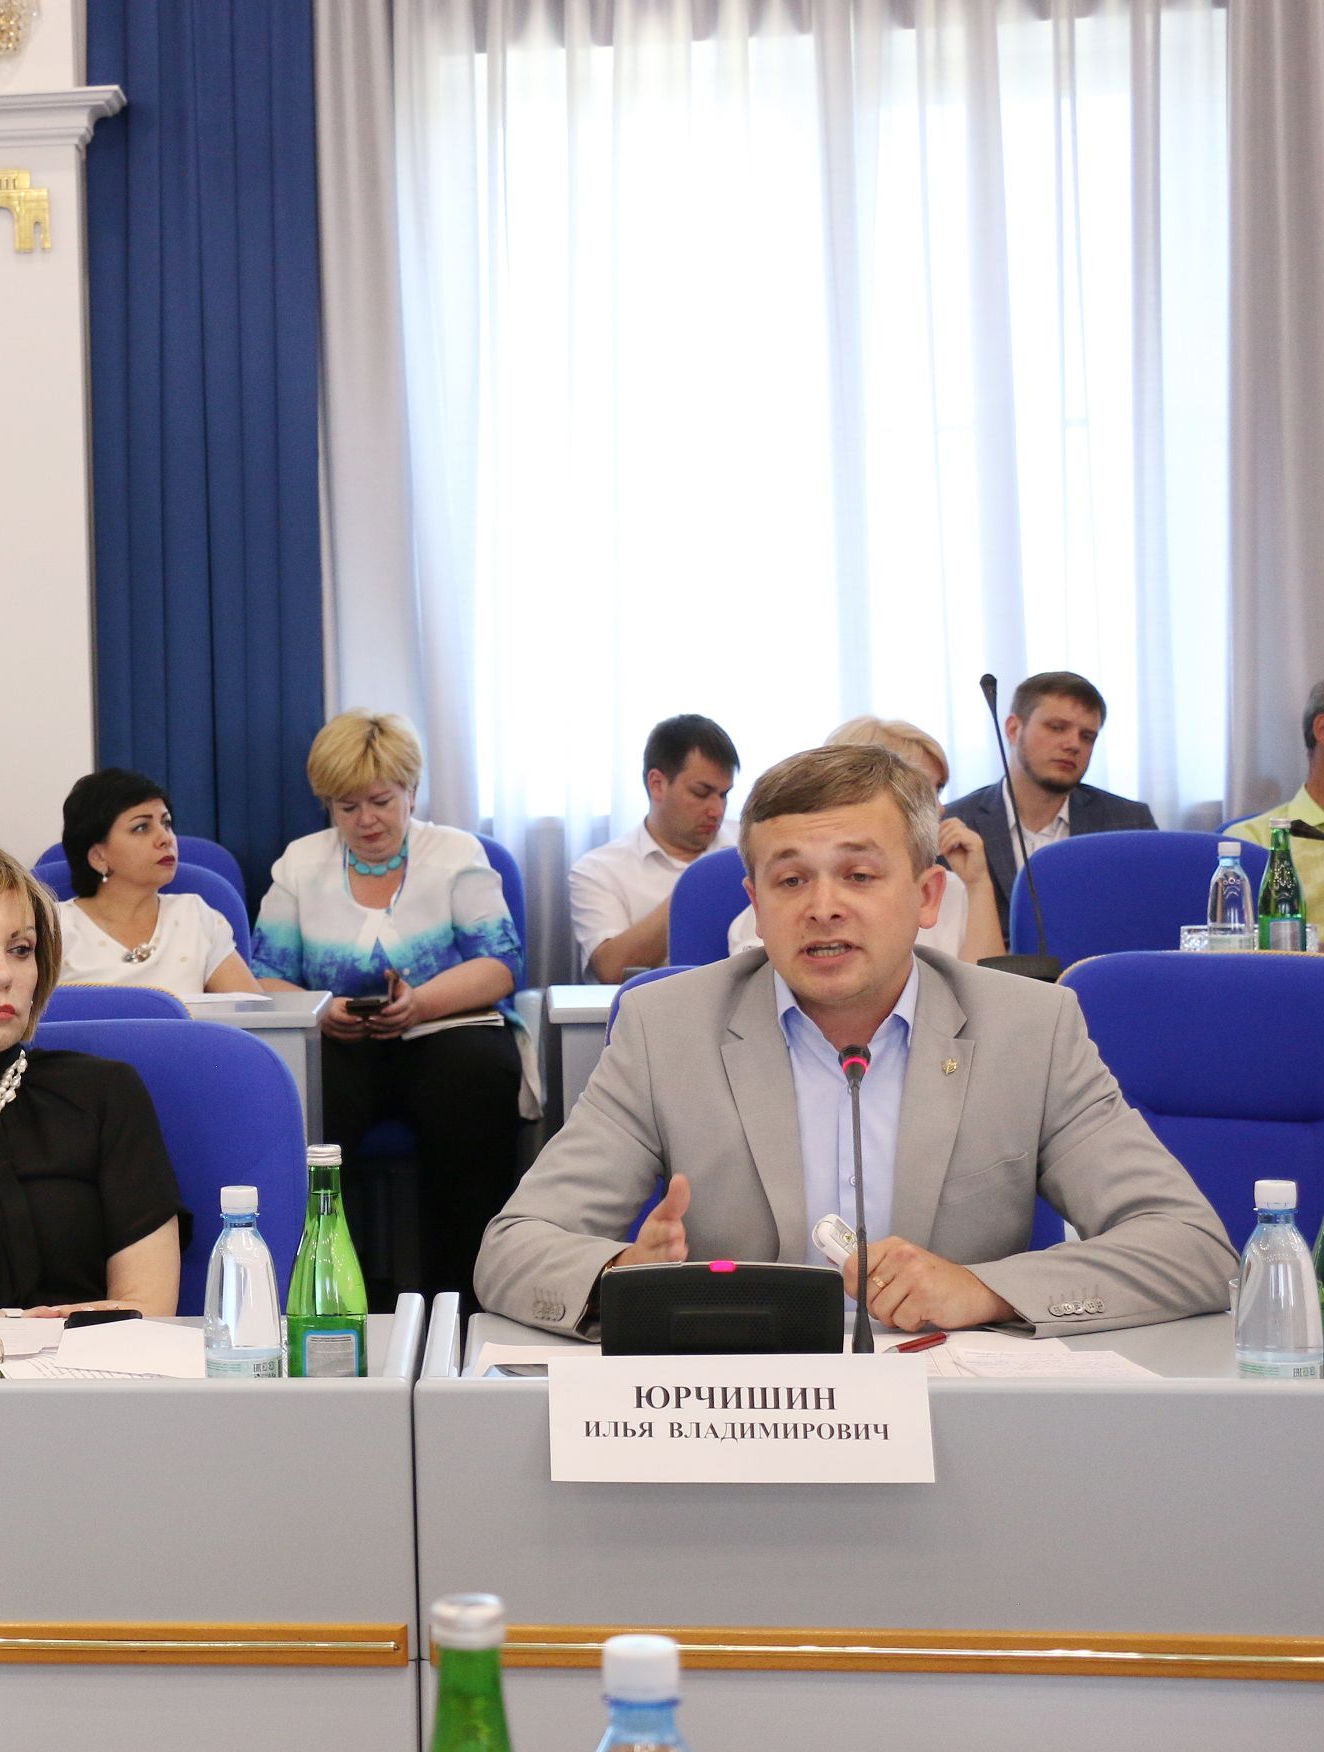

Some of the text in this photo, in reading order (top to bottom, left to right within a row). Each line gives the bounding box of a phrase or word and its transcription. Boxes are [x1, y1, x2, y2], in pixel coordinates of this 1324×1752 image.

[633, 1385, 837, 1410] ЮРЧИШИН
[583, 1420, 890, 1443] ИЛЬЯ ВЛАДИМИРОВИЧ
